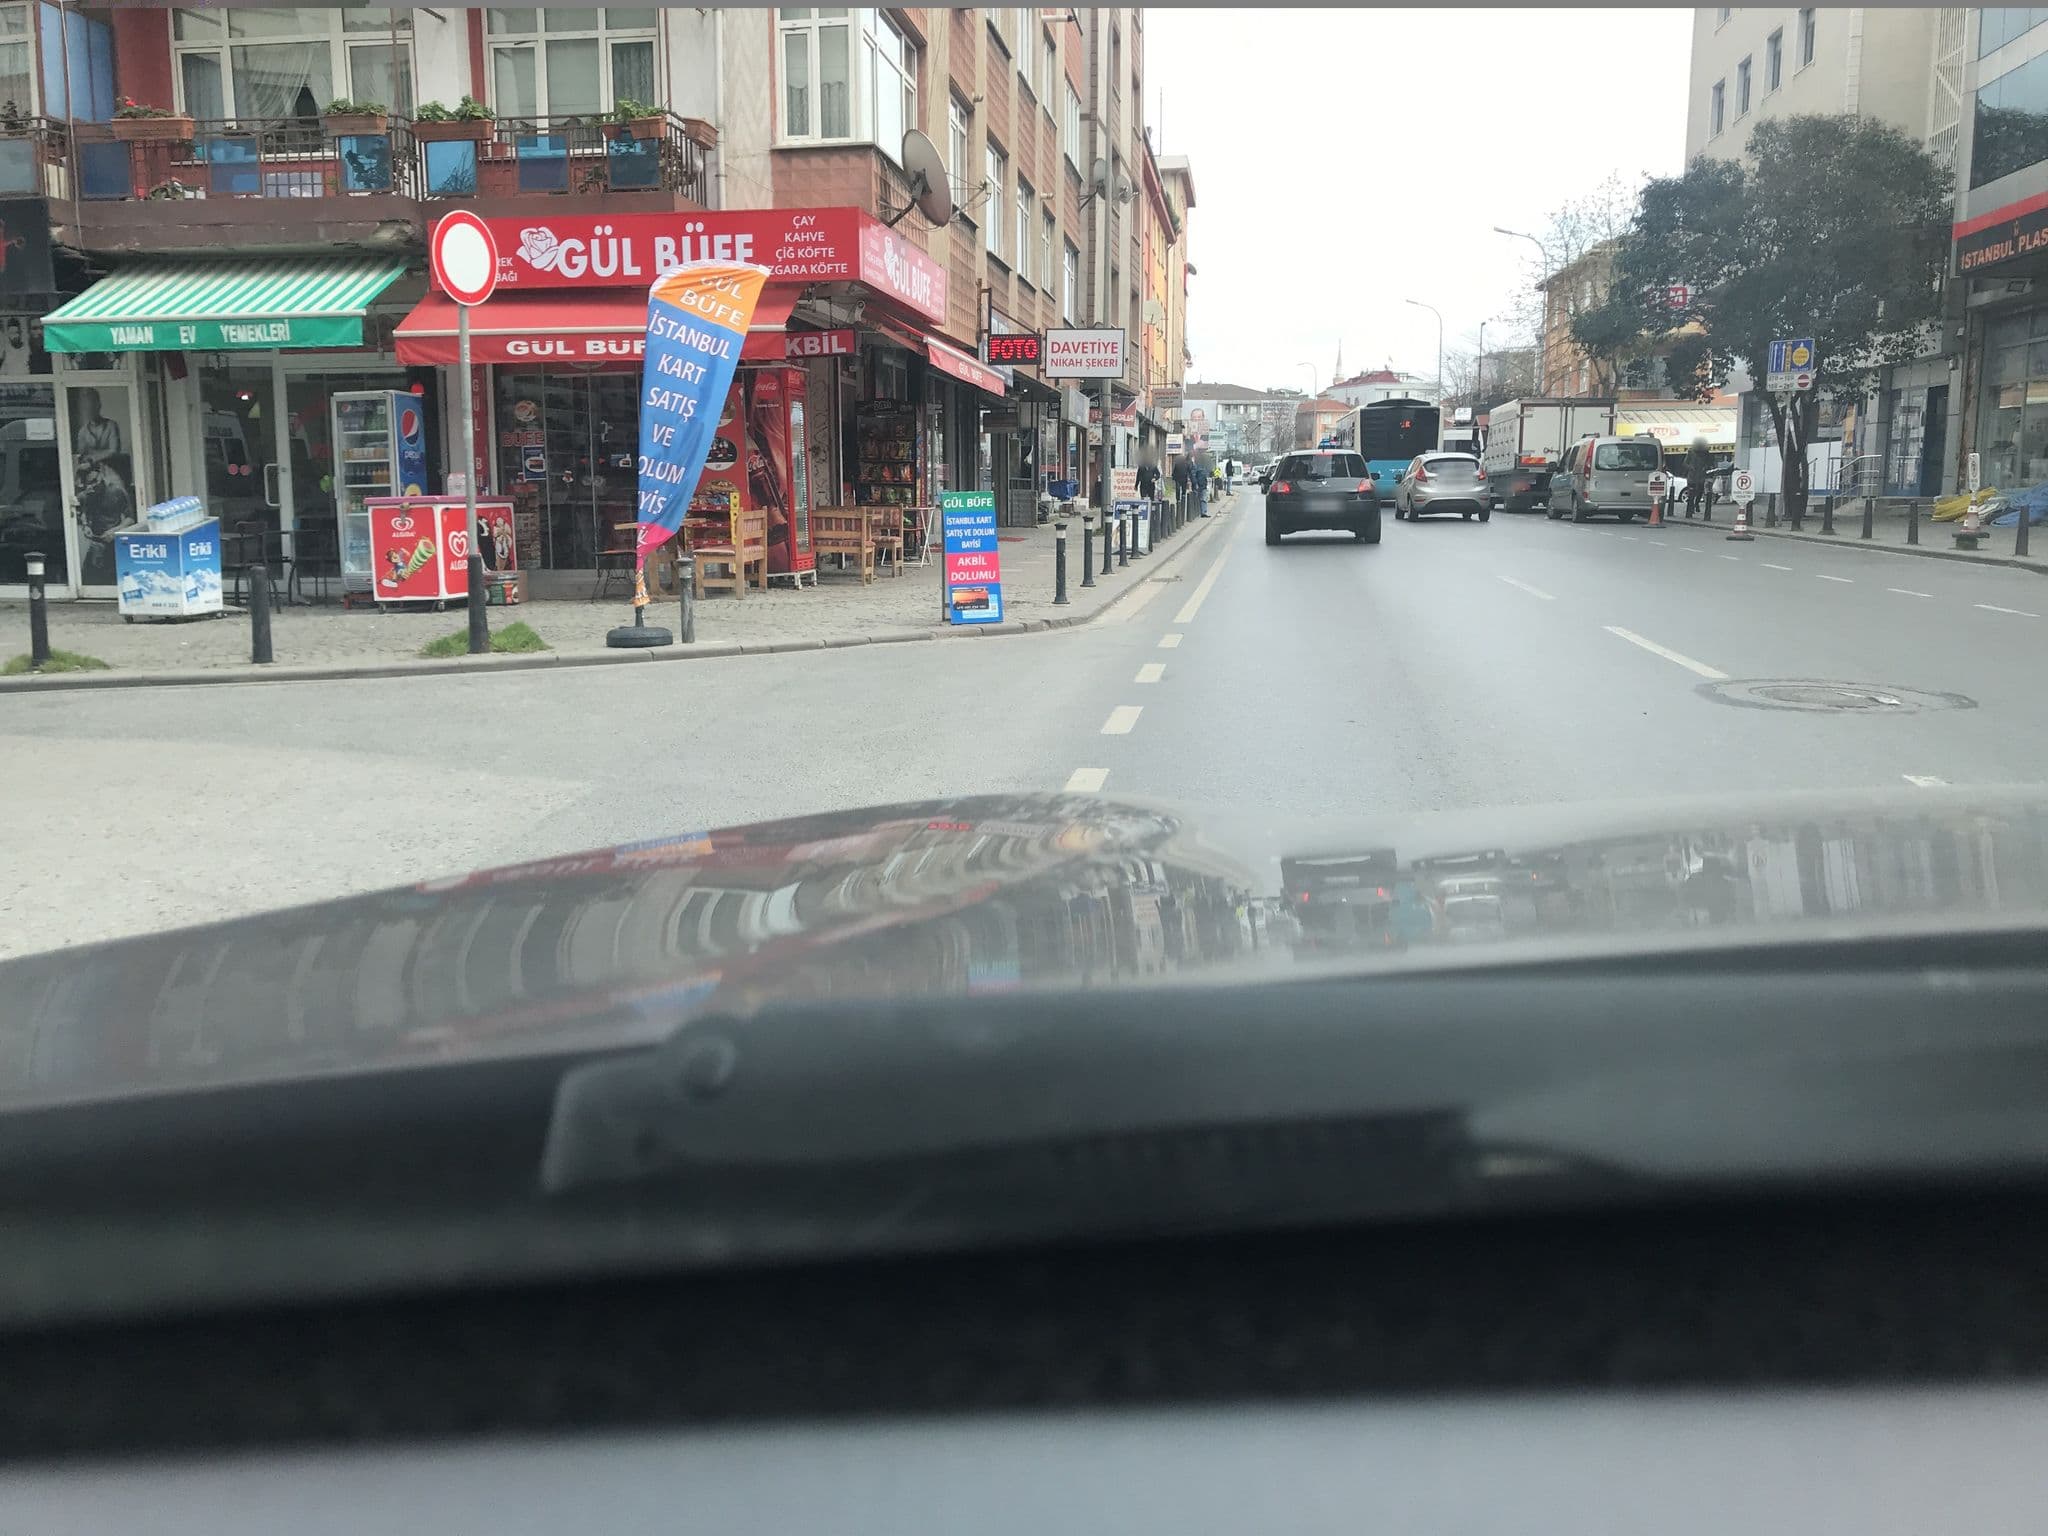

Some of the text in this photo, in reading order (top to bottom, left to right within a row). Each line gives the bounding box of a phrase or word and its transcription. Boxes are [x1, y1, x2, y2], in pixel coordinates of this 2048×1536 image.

[792, 215, 817, 229] ÇAY
[784, 231, 825, 244] KAHVE
[556, 224, 641, 278] GÜL
[776, 244, 835, 262] ÇİĞ KÖFTE
[811, 259, 848, 274] KÖFTE
[680, 288, 746, 326] BÜFE
[110, 319, 290, 344] YAMAN EV YEMEKLERİ
[648, 309, 731, 360] İSTANBUL
[506, 338, 647, 356] GÜL BÜF
[785, 331, 847, 357] KBİL
[990, 338, 1038, 360] FOTO
[1050, 338, 1119, 355] DAVETİYE
[657, 352, 707, 385] KART
[1050, 358, 1118, 371] NİKAH ŞEKERİ
[646, 386, 698, 422] SATIŞ
[652, 424, 675, 447] VE
[638, 456, 686, 485] OLUM
[944, 496, 993, 509] GÜL BÜFE
[946, 515, 992, 526] İSTANBUL KART
[946, 527, 995, 539] SATIŞ VE DOLUM
[129, 543, 168, 559] Erikli
[189, 541, 212, 557] Erikli
[961, 539, 981, 550] BAYİSİ
[450, 559, 469, 572] ALGID
[957, 555, 987, 567] AKBİL
[951, 570, 996, 582] DOLUMU
